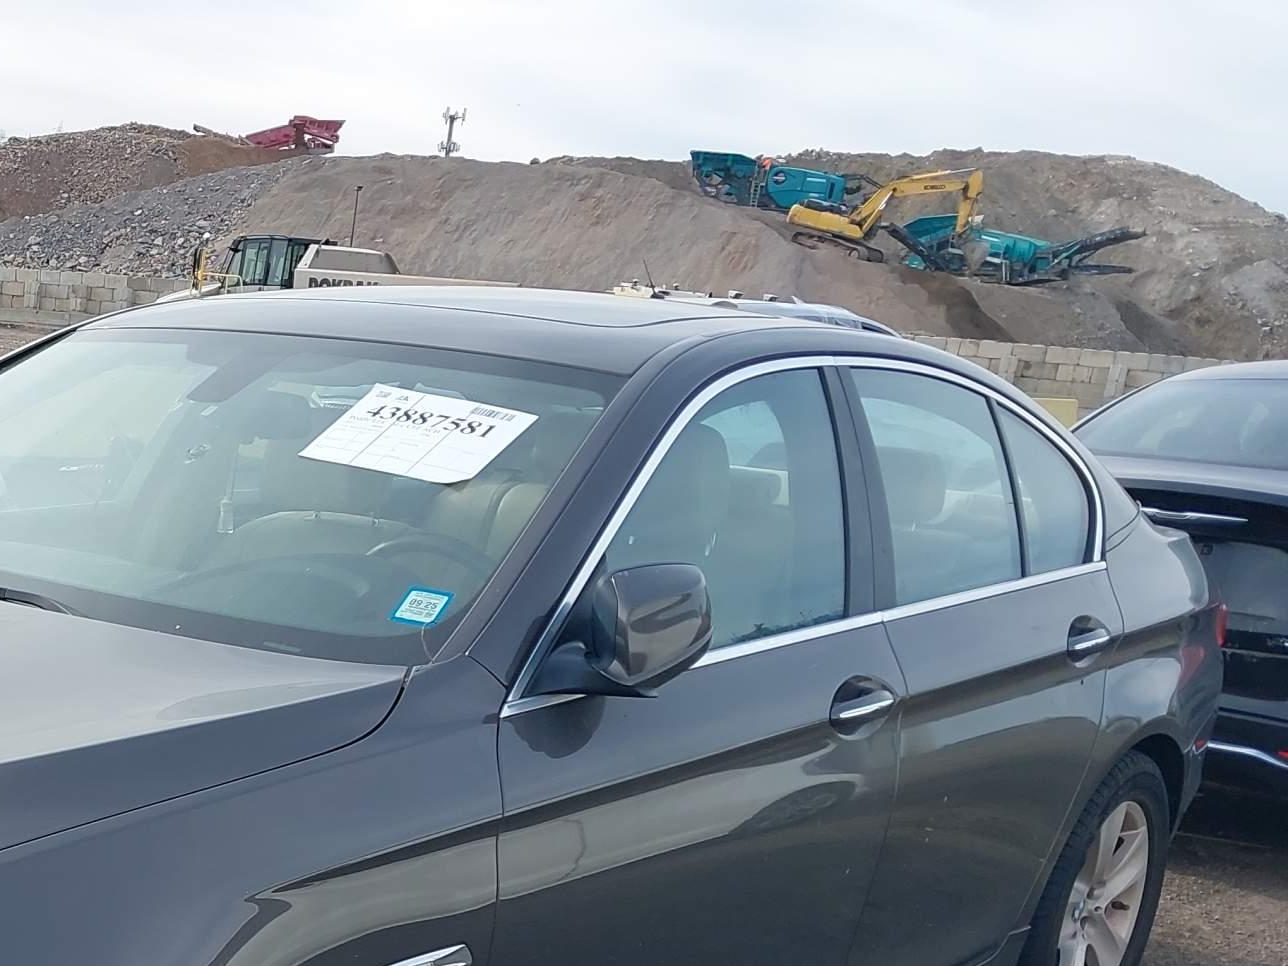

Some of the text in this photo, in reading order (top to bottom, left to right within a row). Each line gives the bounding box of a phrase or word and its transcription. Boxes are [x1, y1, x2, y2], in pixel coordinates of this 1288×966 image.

[367, 404, 497, 438] 43887581
[409, 598, 424, 607] 09
[424, 601, 439, 610] 25
